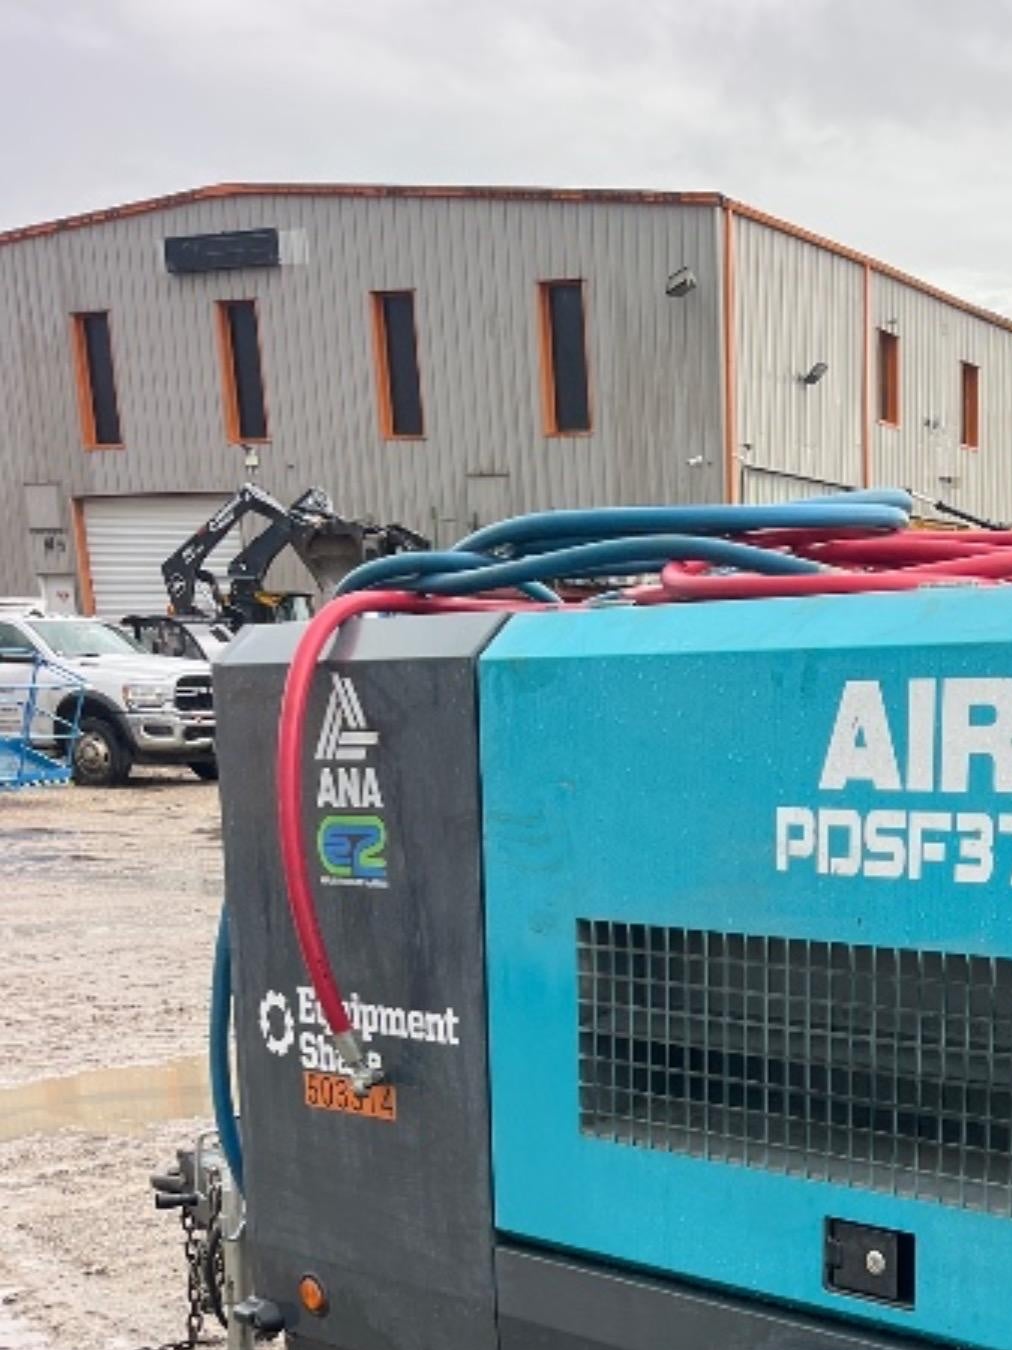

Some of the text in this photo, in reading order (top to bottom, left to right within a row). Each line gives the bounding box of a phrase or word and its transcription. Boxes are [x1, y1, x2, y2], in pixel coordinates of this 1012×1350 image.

[317, 767, 384, 808] ANA
[296, 986, 460, 1045] Eipment
[300, 1030, 382, 1075] Shae
